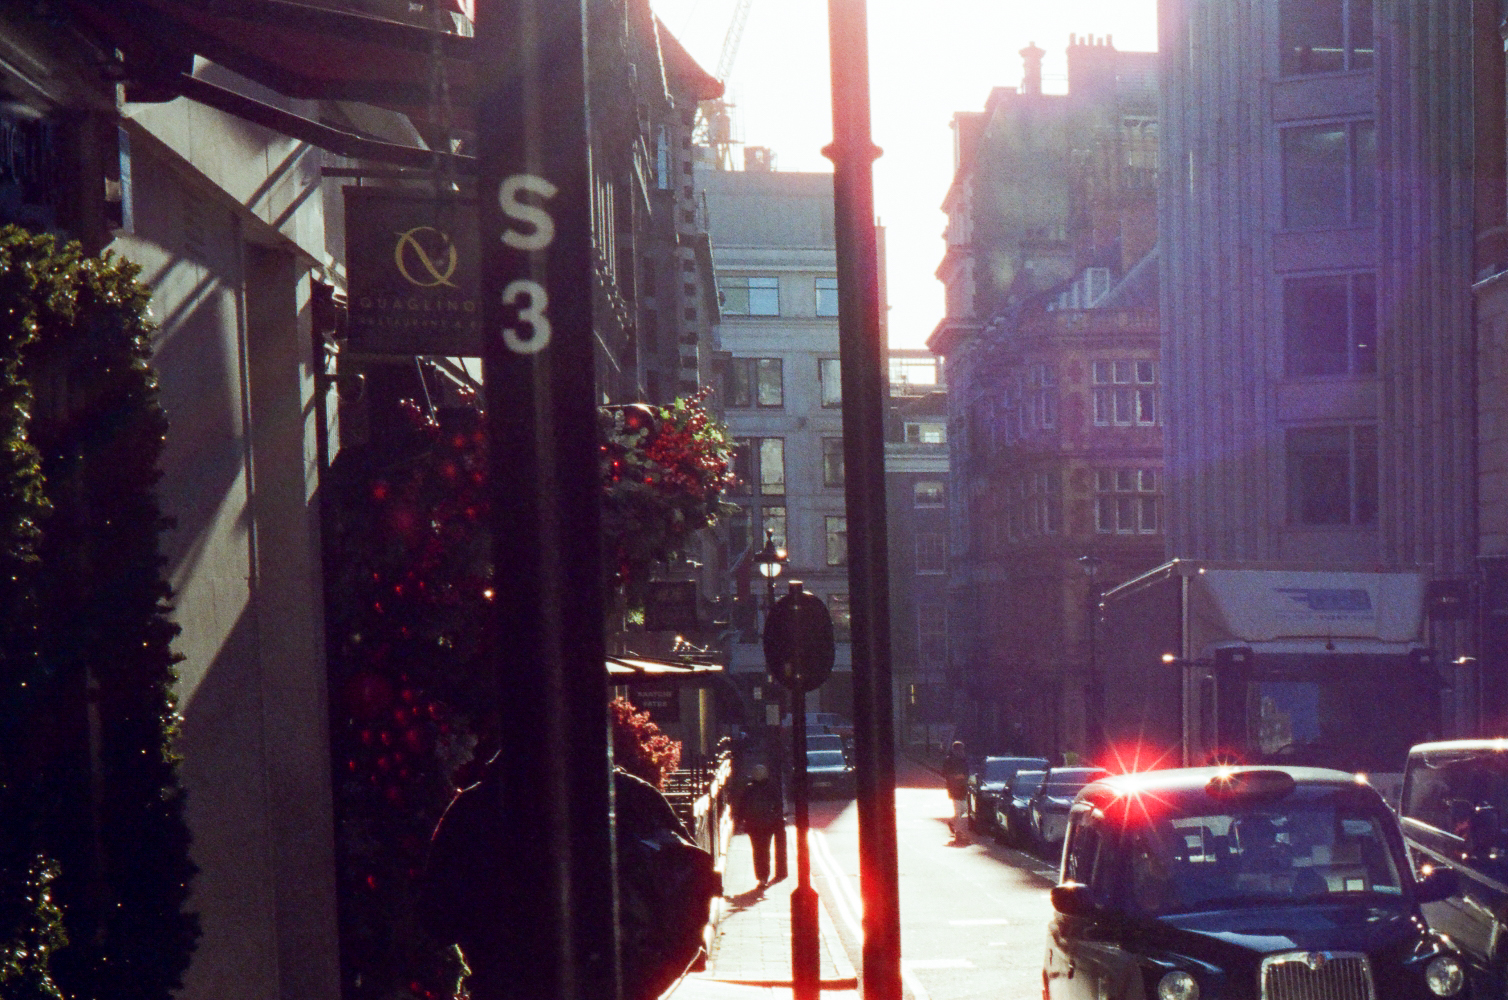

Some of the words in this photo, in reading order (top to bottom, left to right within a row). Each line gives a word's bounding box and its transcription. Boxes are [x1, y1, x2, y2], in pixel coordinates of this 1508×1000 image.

[498, 174, 558, 251] S
[359, 297, 475, 312] QUAGLINO
[501, 279, 553, 355] 3
